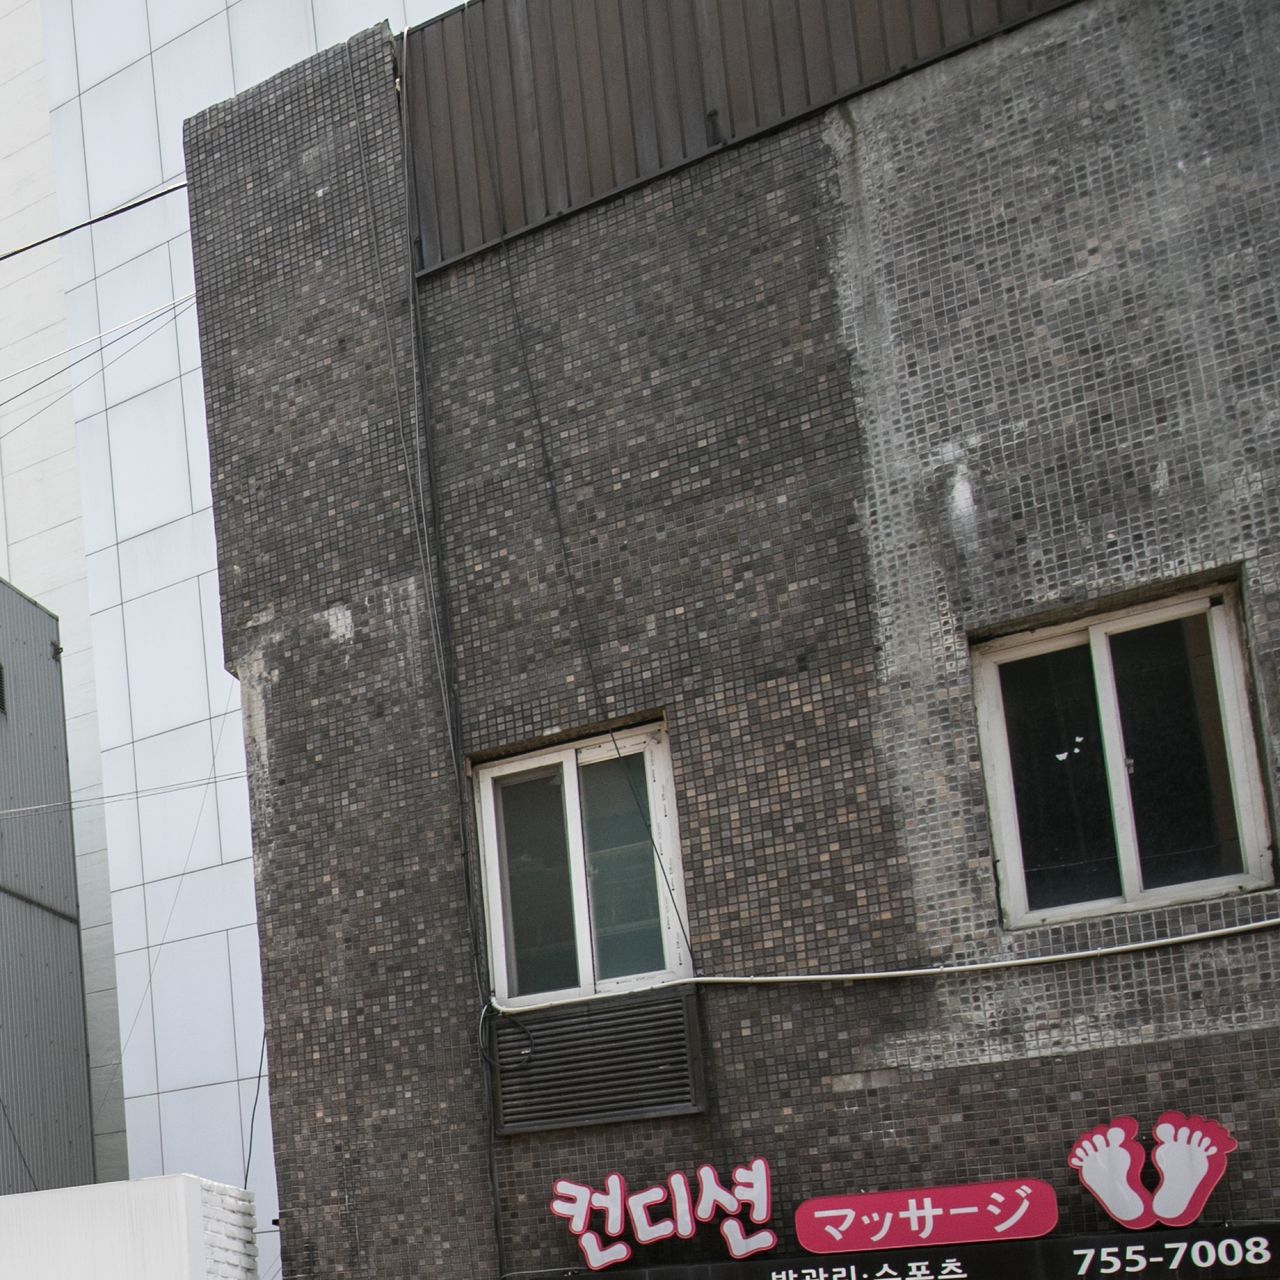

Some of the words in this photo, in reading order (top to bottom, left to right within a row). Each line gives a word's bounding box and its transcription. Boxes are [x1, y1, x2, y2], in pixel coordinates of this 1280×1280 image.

[549, 1156, 778, 1271] 컨디션
[813, 1184, 1034, 1242] マッサージ
[1073, 1236, 1272, 1277] 755-7008
